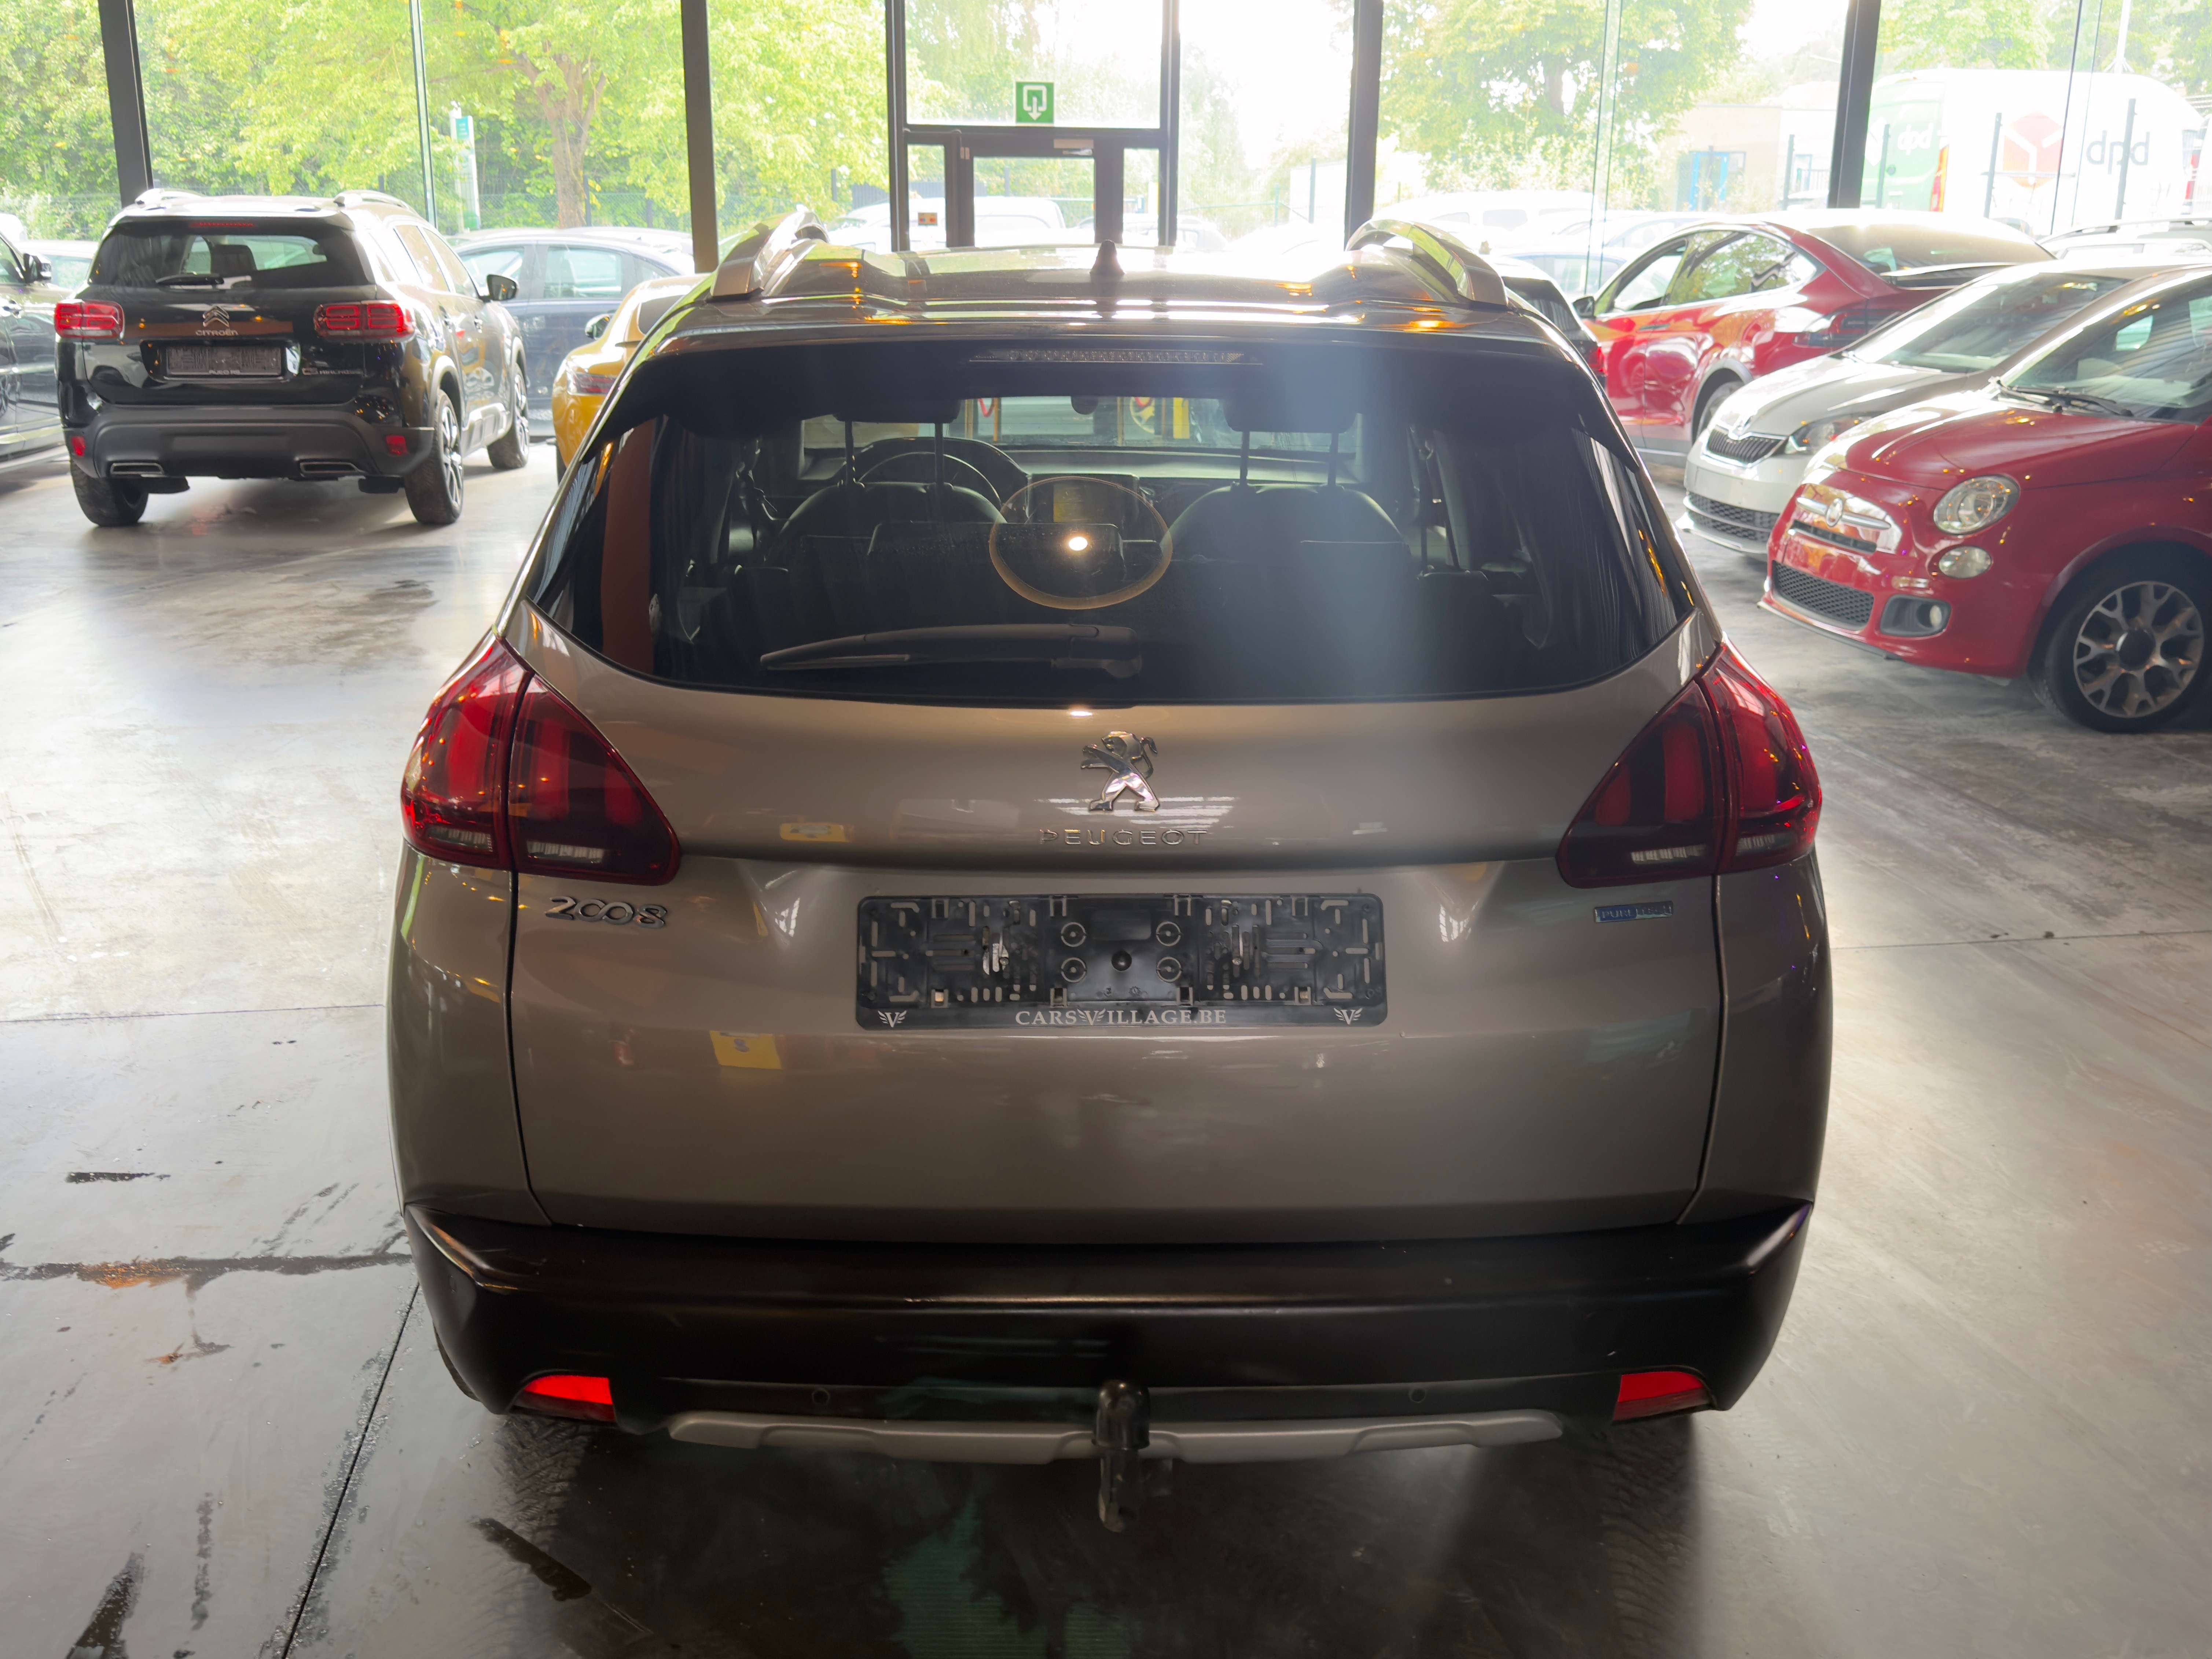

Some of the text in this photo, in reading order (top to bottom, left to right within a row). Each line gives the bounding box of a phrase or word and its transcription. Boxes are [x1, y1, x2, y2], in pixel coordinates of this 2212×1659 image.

[1897, 123, 1933, 156] dpd
[2086, 130, 2150, 175] dpd
[1039, 829, 1207, 845] PEUGEOT
[545, 896, 667, 929] 2008
[1015, 1009, 1227, 1026] CARSVILLAGE.BE
